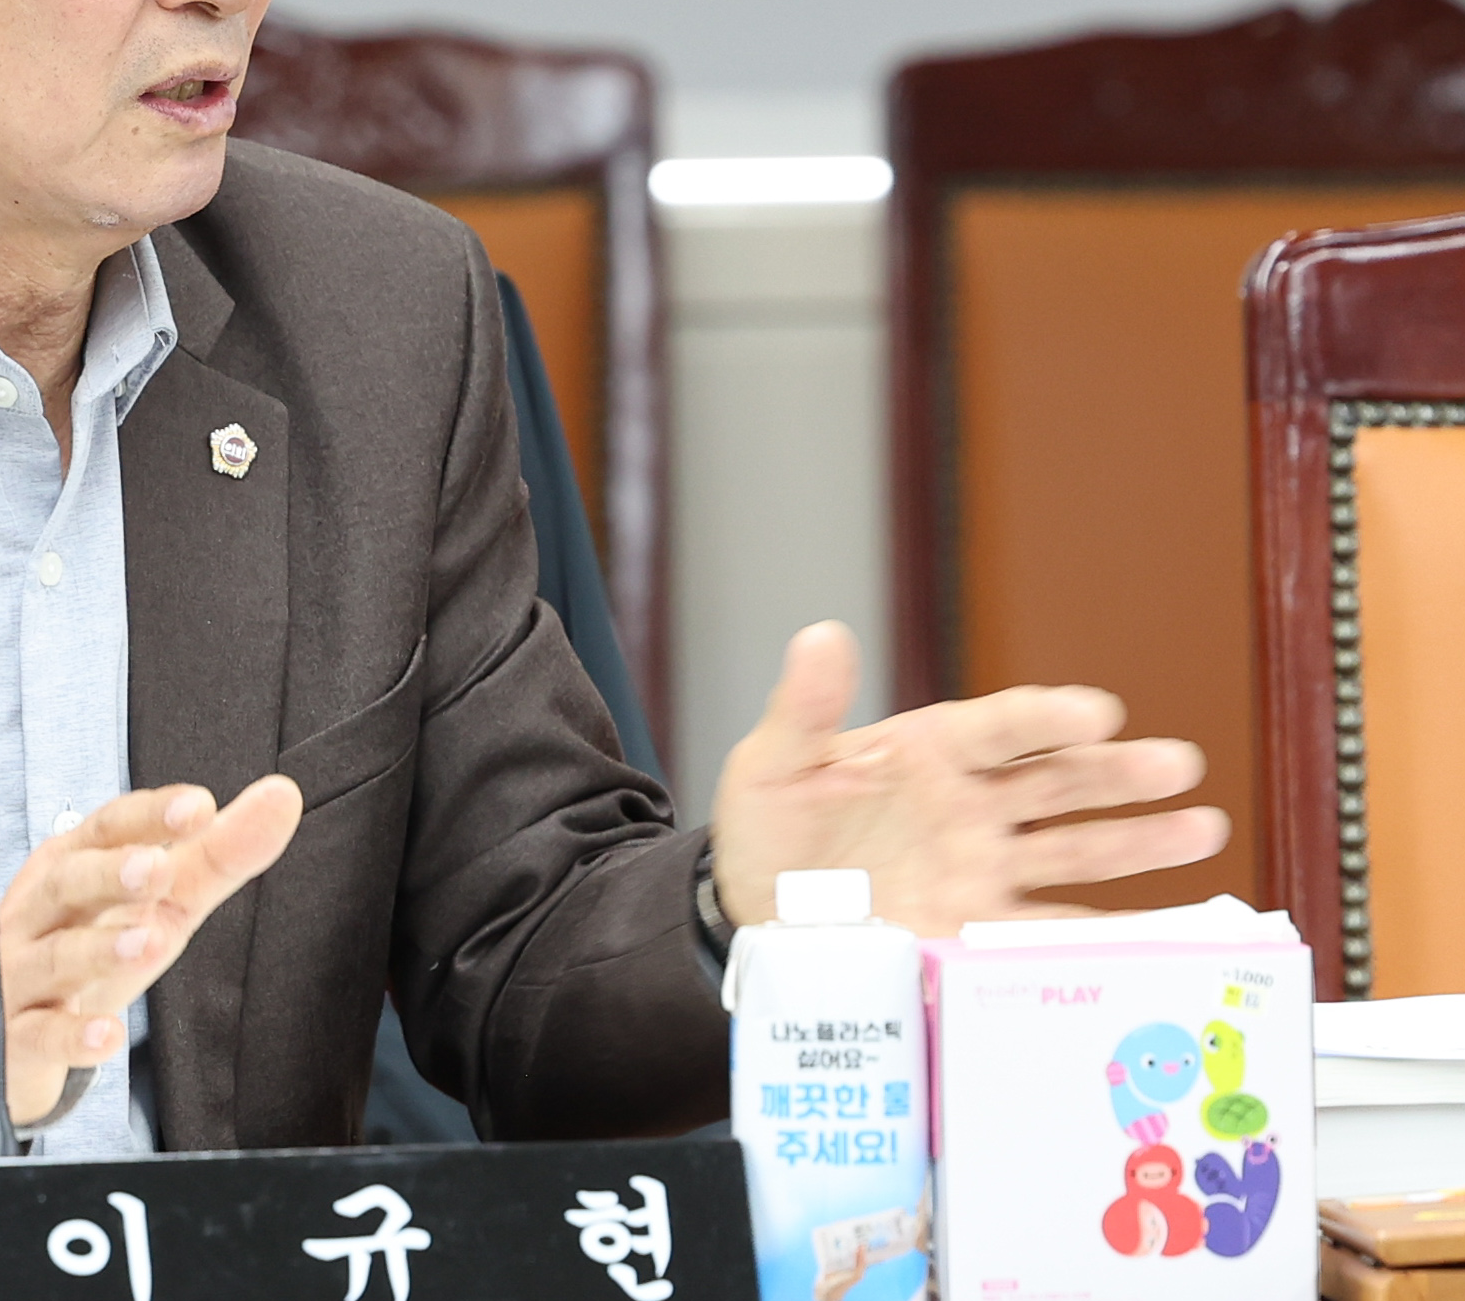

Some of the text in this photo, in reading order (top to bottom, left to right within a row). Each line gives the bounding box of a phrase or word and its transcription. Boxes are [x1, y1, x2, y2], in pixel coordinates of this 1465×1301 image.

[1041, 984, 1103, 1005] PLAY
[770, 1020, 903, 1043] 나노플라스틱
[759, 1081, 869, 1120] 깨끗한
[776, 1129, 899, 1166] 주세요!
